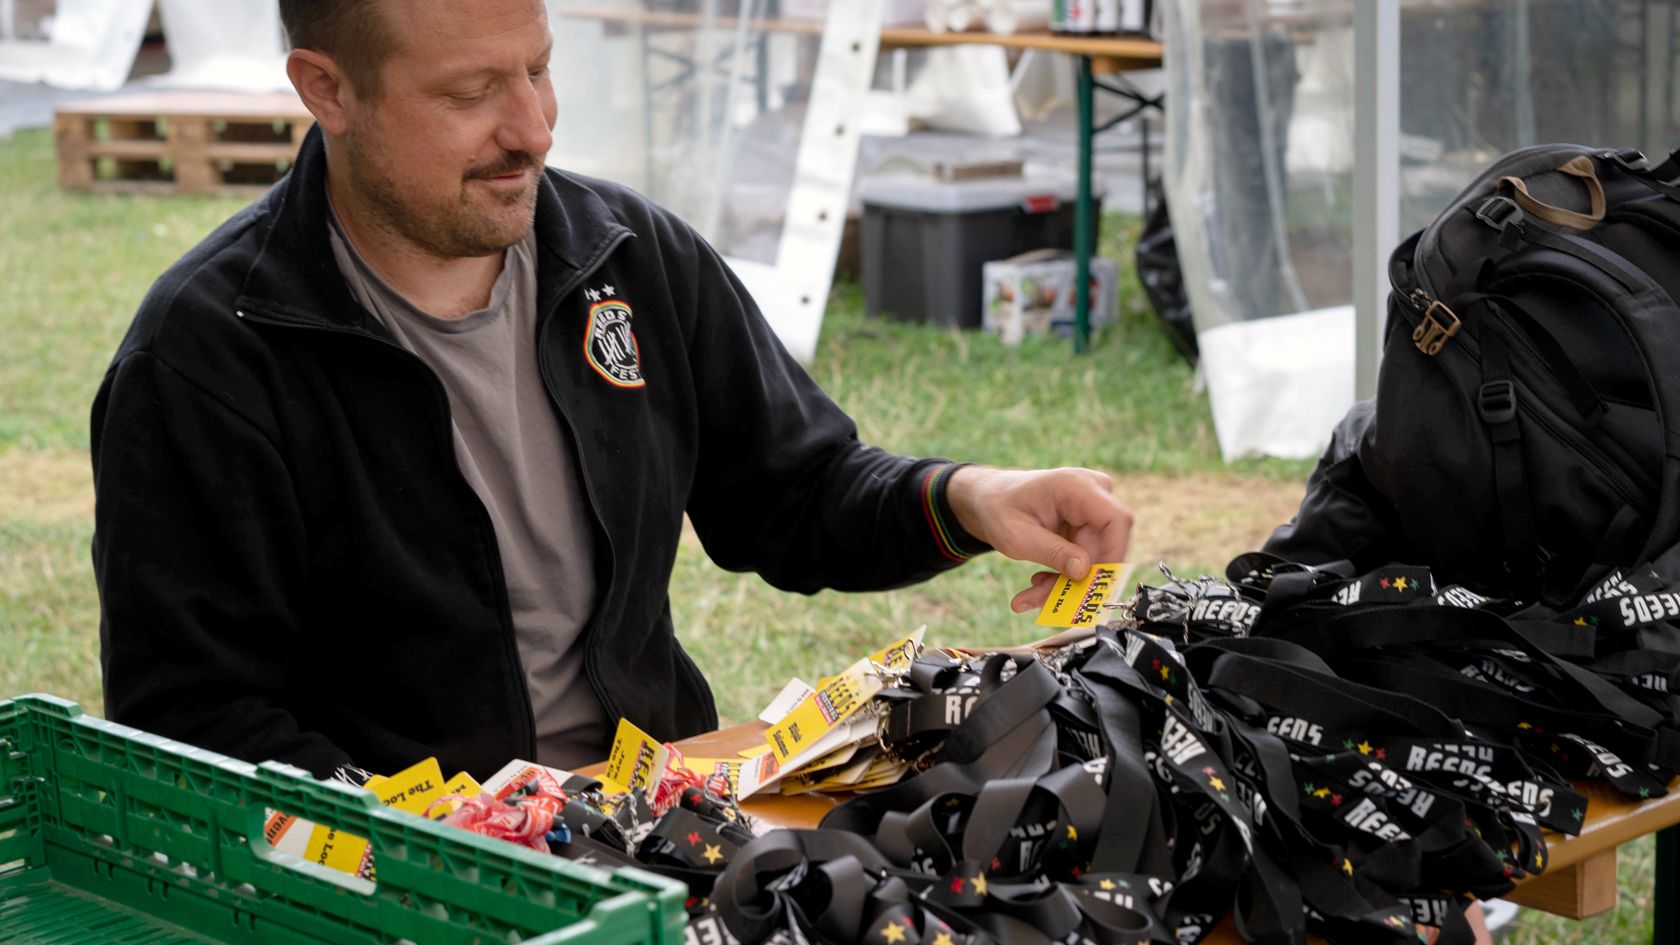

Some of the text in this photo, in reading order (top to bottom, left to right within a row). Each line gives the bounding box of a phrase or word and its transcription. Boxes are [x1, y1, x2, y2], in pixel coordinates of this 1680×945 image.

[609, 367, 640, 380] FES
[1161, 709, 1206, 766] REED
[409, 779, 434, 797] The
